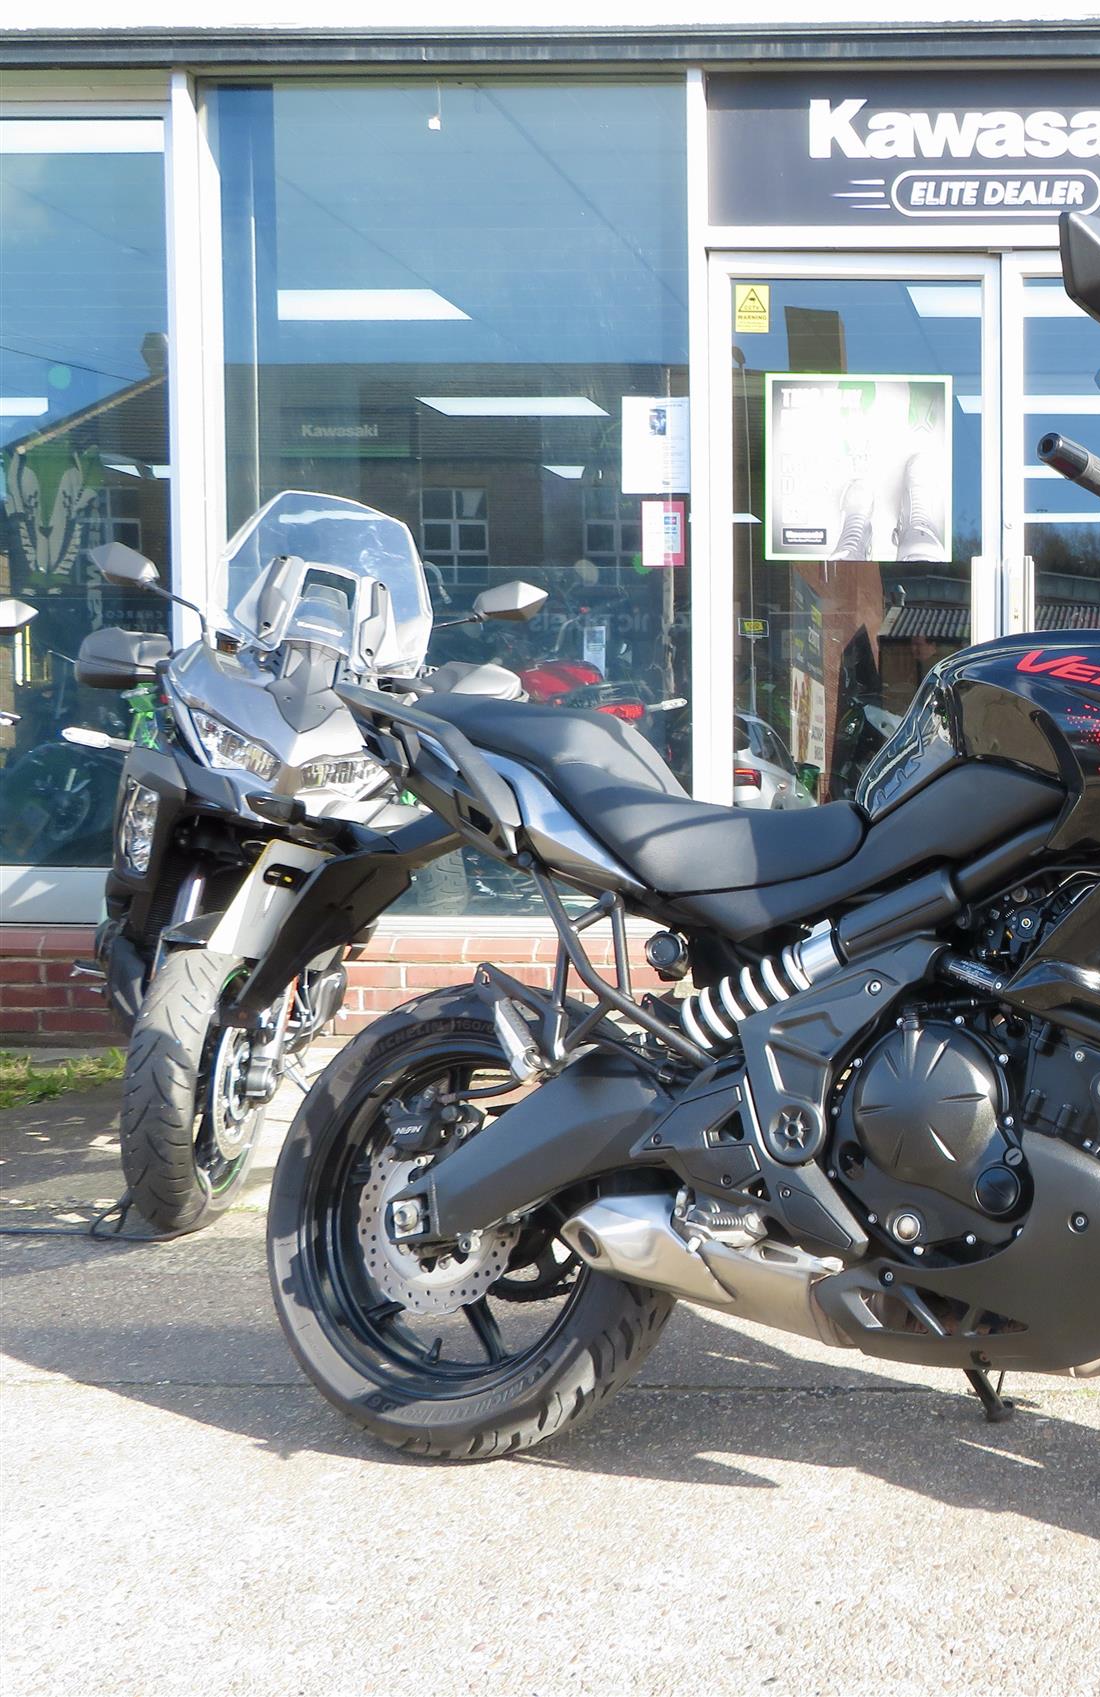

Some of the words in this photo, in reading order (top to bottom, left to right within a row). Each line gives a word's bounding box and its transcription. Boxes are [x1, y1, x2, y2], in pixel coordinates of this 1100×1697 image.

[910, 180, 980, 205] ELITE
[985, 180, 1086, 205] DEALER
[301, 424, 379, 437] Kawasaki
[457, 1020, 494, 1034] 160/6
